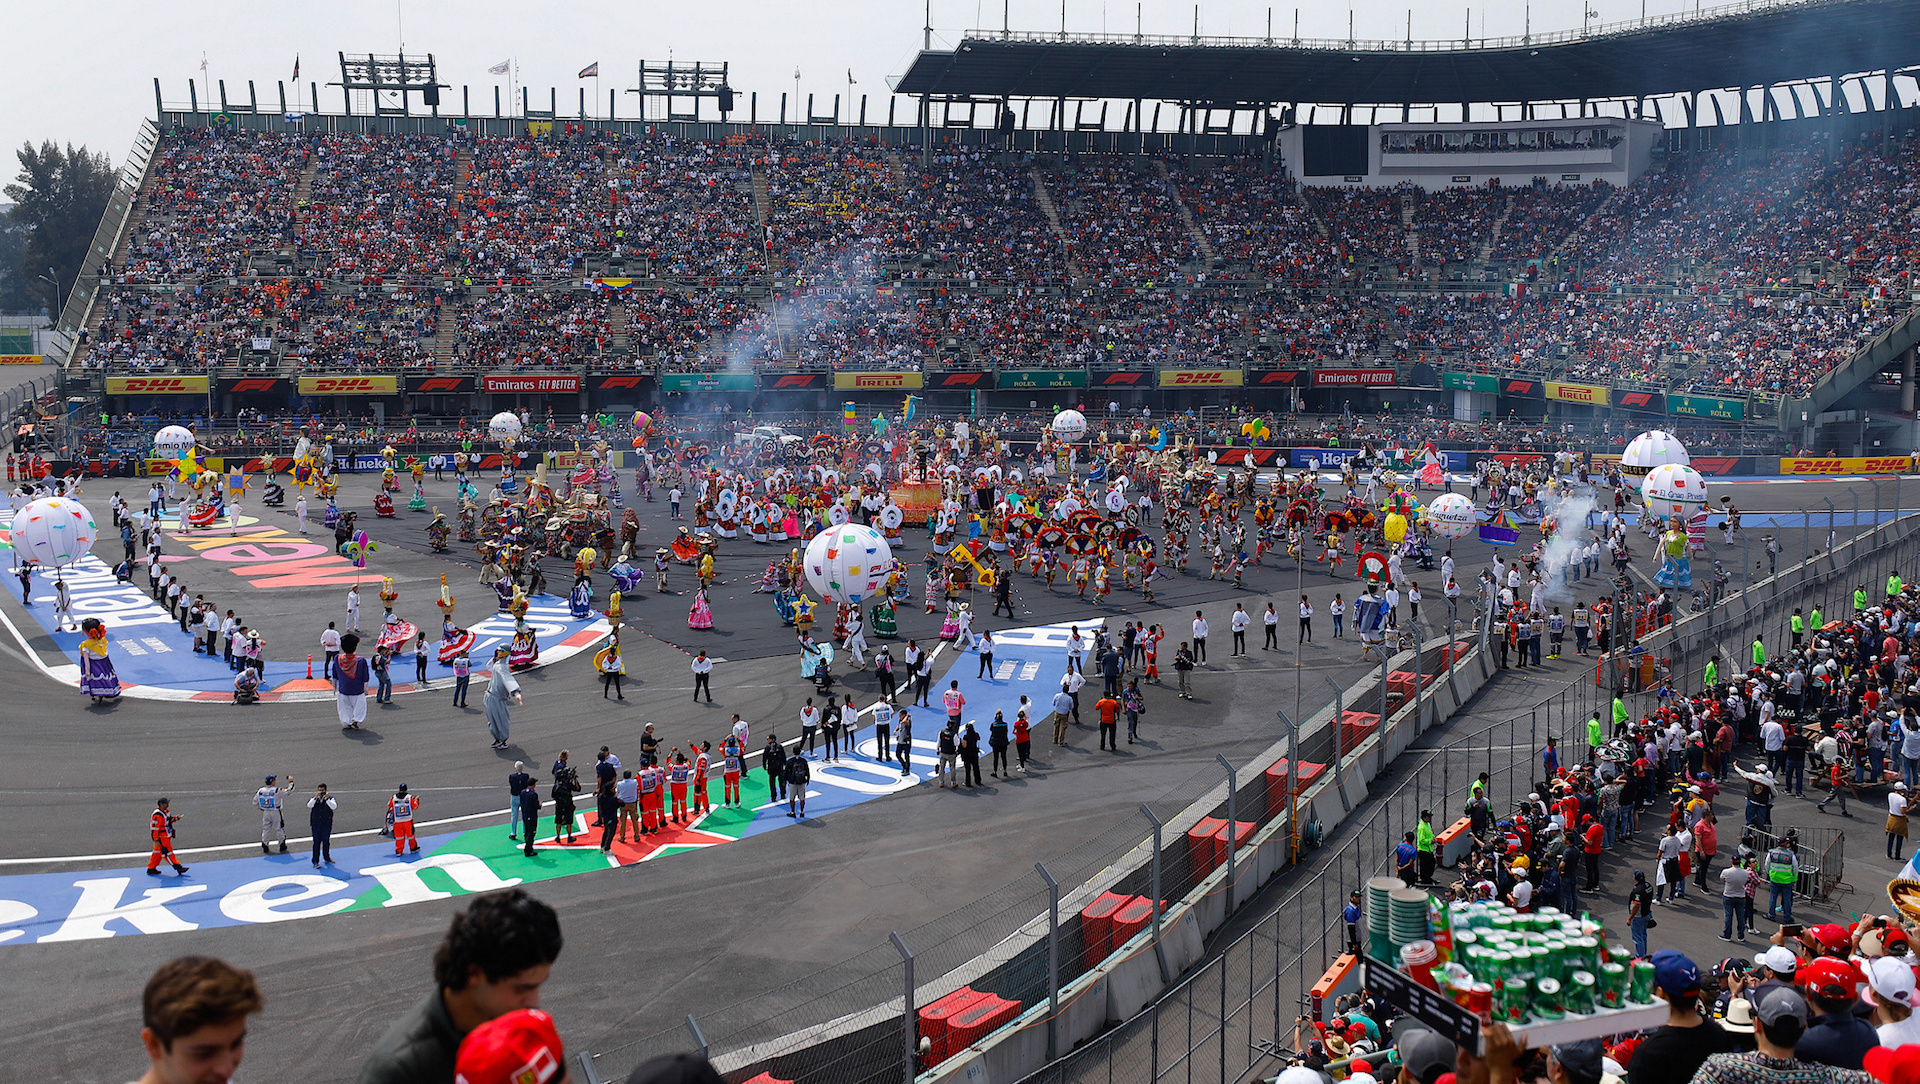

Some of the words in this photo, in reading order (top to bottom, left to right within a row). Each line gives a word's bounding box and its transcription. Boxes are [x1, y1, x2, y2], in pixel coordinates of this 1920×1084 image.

[1, 356, 34, 364] DHL
[856, 376, 903, 387] PIRELLI
[1174, 372, 1224, 384] DHL
[1318, 373, 1358, 383] Emirates
[1360, 372, 1374, 383] FLY
[1374, 372, 1395, 383] BETTER
[125, 379, 186, 391] DHL
[315, 379, 374, 391] DHL
[488, 380, 535, 390] Emirates
[538, 379, 553, 390] FLY
[554, 379, 577, 390] BETTER
[1559, 386, 1592, 401] PIRELLI
[1676, 406, 1697, 414] ROLEX
[1710, 409, 1732, 418] ROLEX
[1793, 460, 1845, 472] DHL
[1864, 459, 1908, 472] DHL
[0, 853, 523, 945] ken
[966, 1065, 982, 1080] 891
